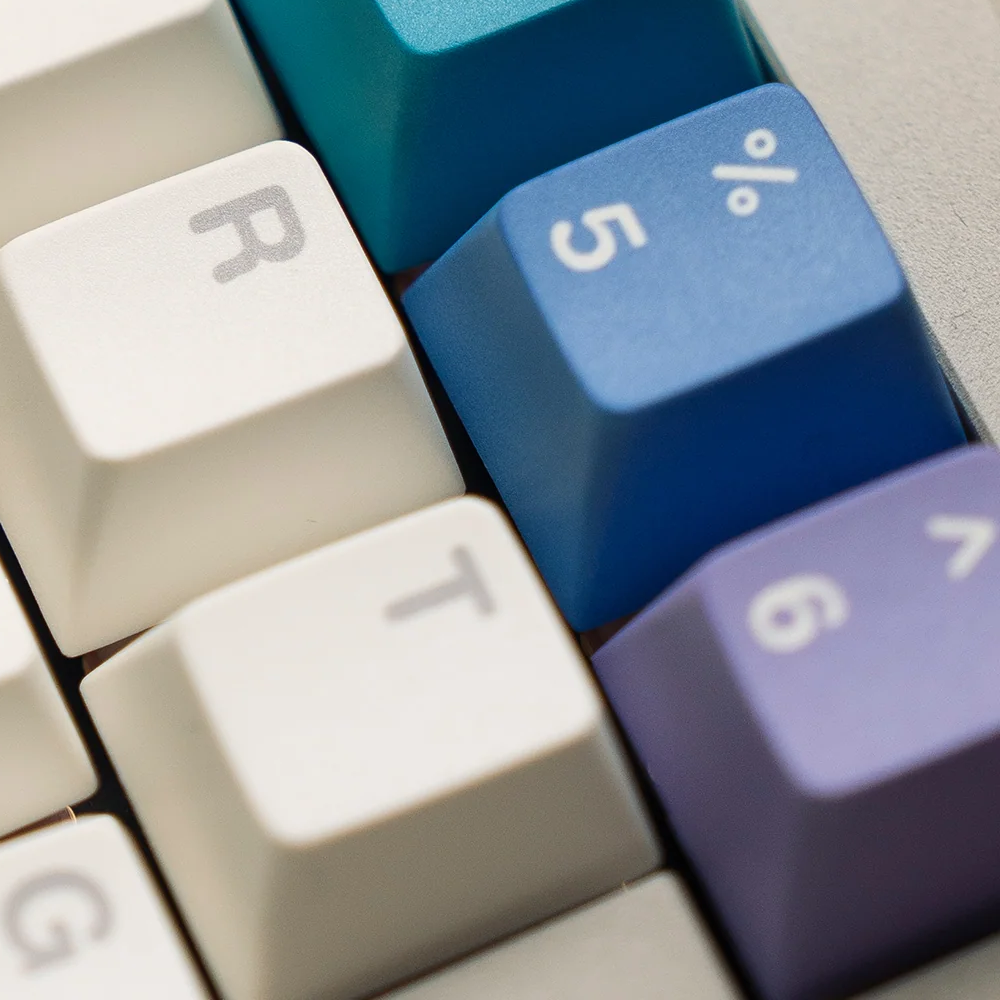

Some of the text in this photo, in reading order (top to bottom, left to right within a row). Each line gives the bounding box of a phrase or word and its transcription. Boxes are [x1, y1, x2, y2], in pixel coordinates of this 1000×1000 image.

[711, 129, 798, 217] %
[188, 184, 308, 285] R
[550, 202, 648, 272] 5
[384, 544, 497, 624] T
[747, 572, 849, 653] 6
[0, 866, 115, 978] G
